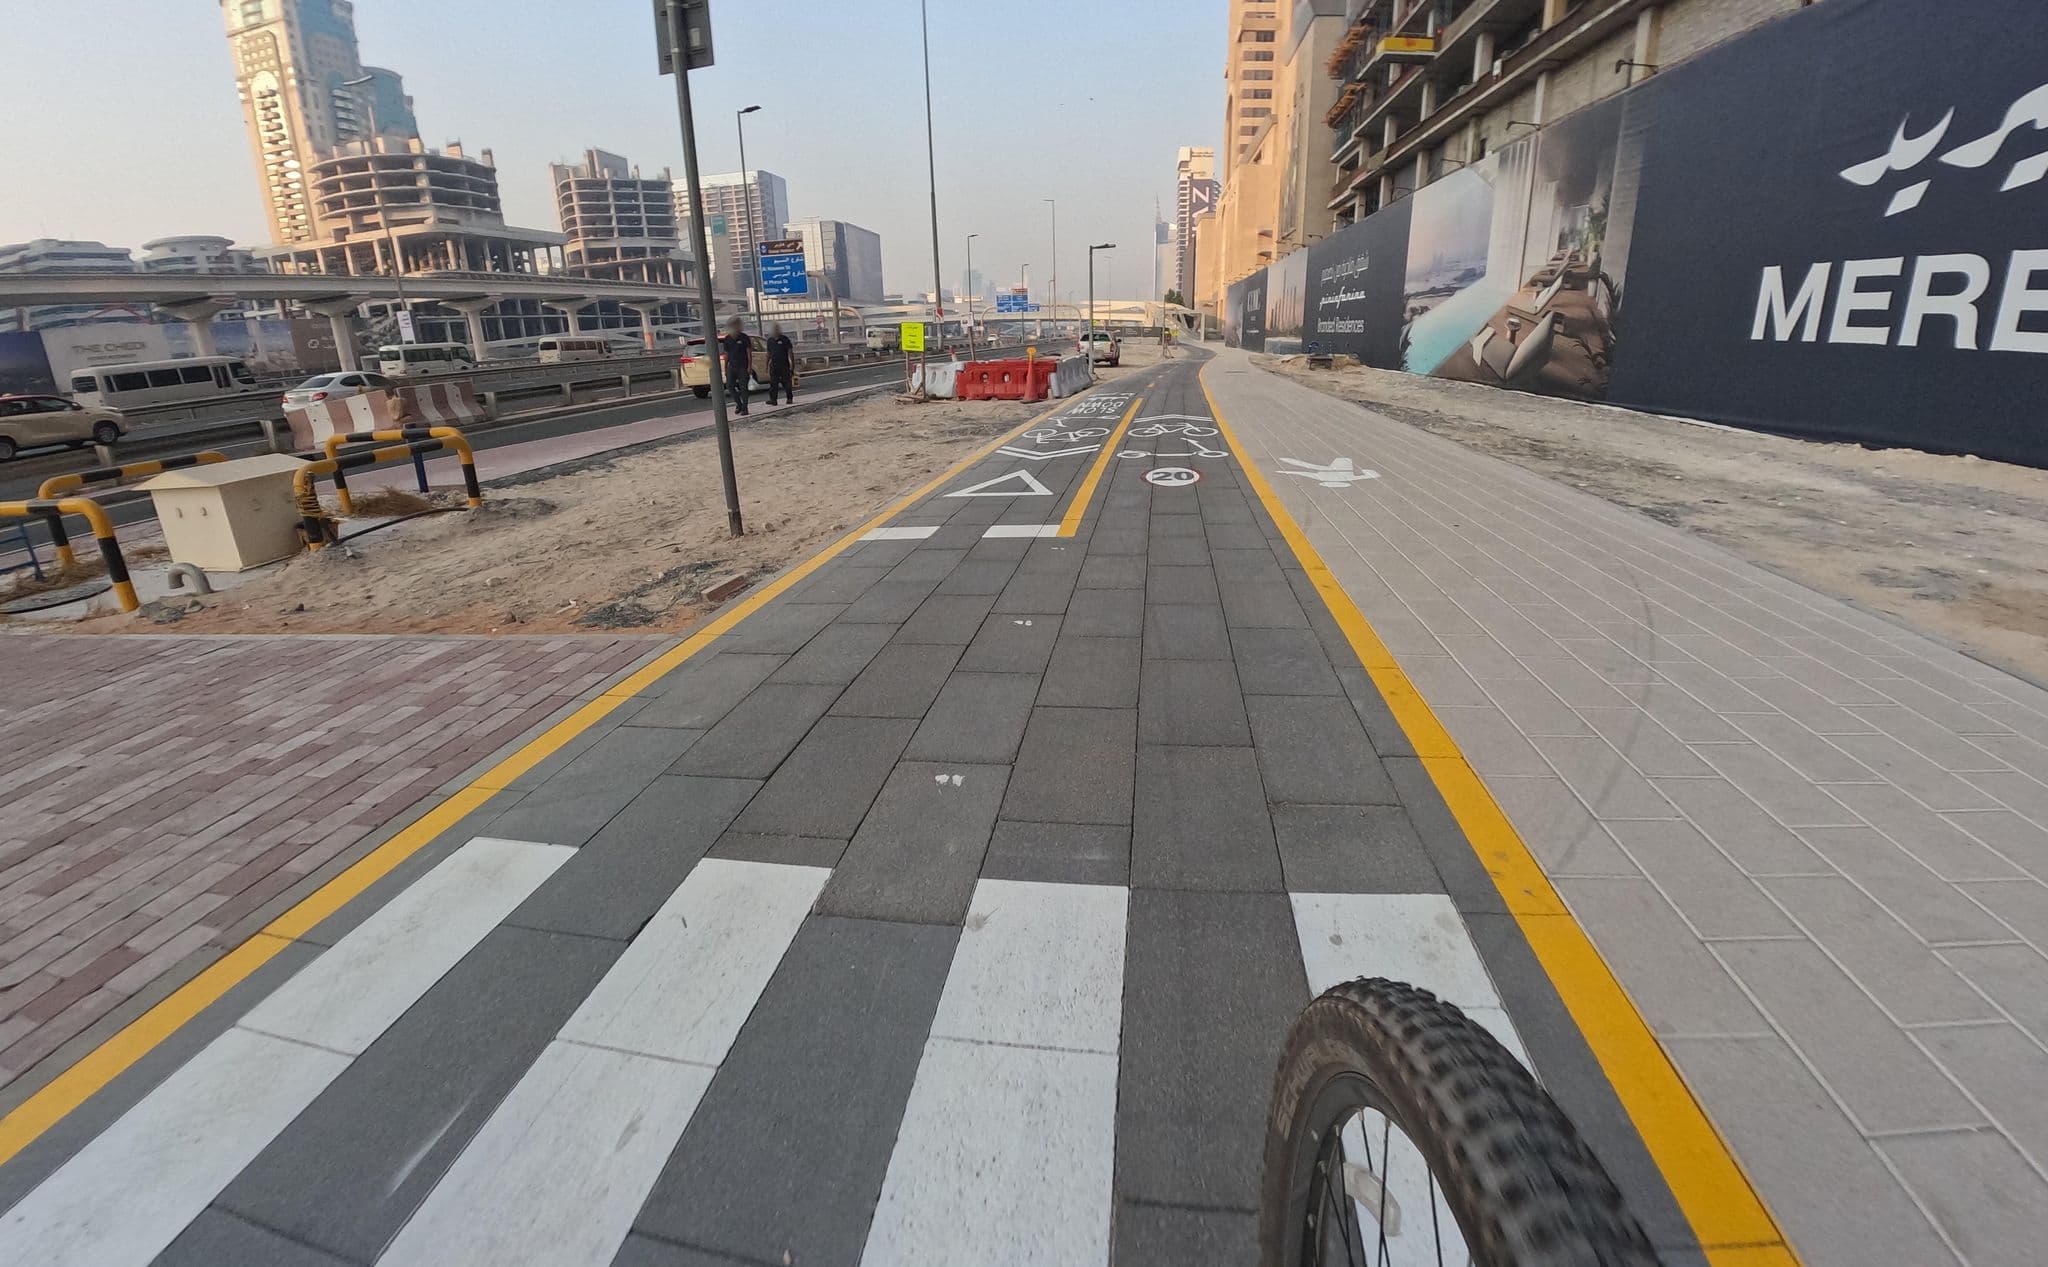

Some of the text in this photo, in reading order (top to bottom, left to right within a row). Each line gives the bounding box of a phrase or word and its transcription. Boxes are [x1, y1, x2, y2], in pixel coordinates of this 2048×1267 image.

[1078, 401, 1124, 409] DOWN
[1066, 407, 1116, 415] SLOW
[1152, 471, 1194, 481] 20
